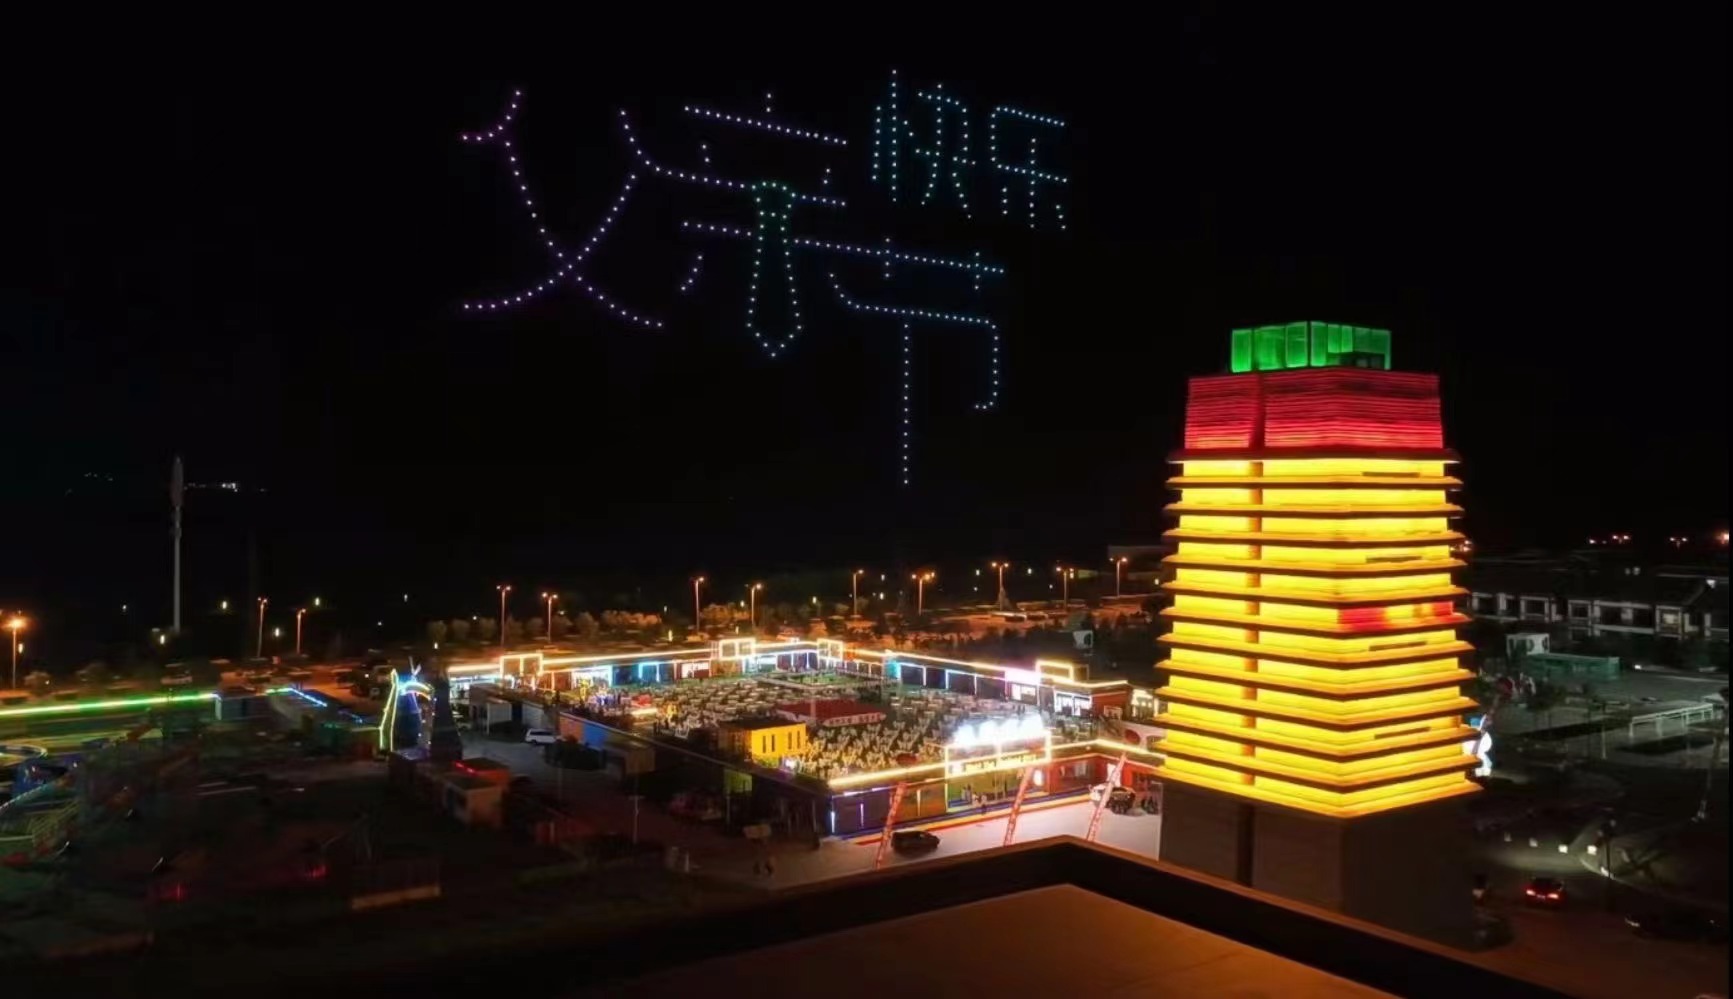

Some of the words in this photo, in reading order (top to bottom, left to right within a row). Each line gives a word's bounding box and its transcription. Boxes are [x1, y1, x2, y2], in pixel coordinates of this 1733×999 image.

[461, 90, 1005, 485] 父亲节
[872, 69, 1067, 230] 快乐
